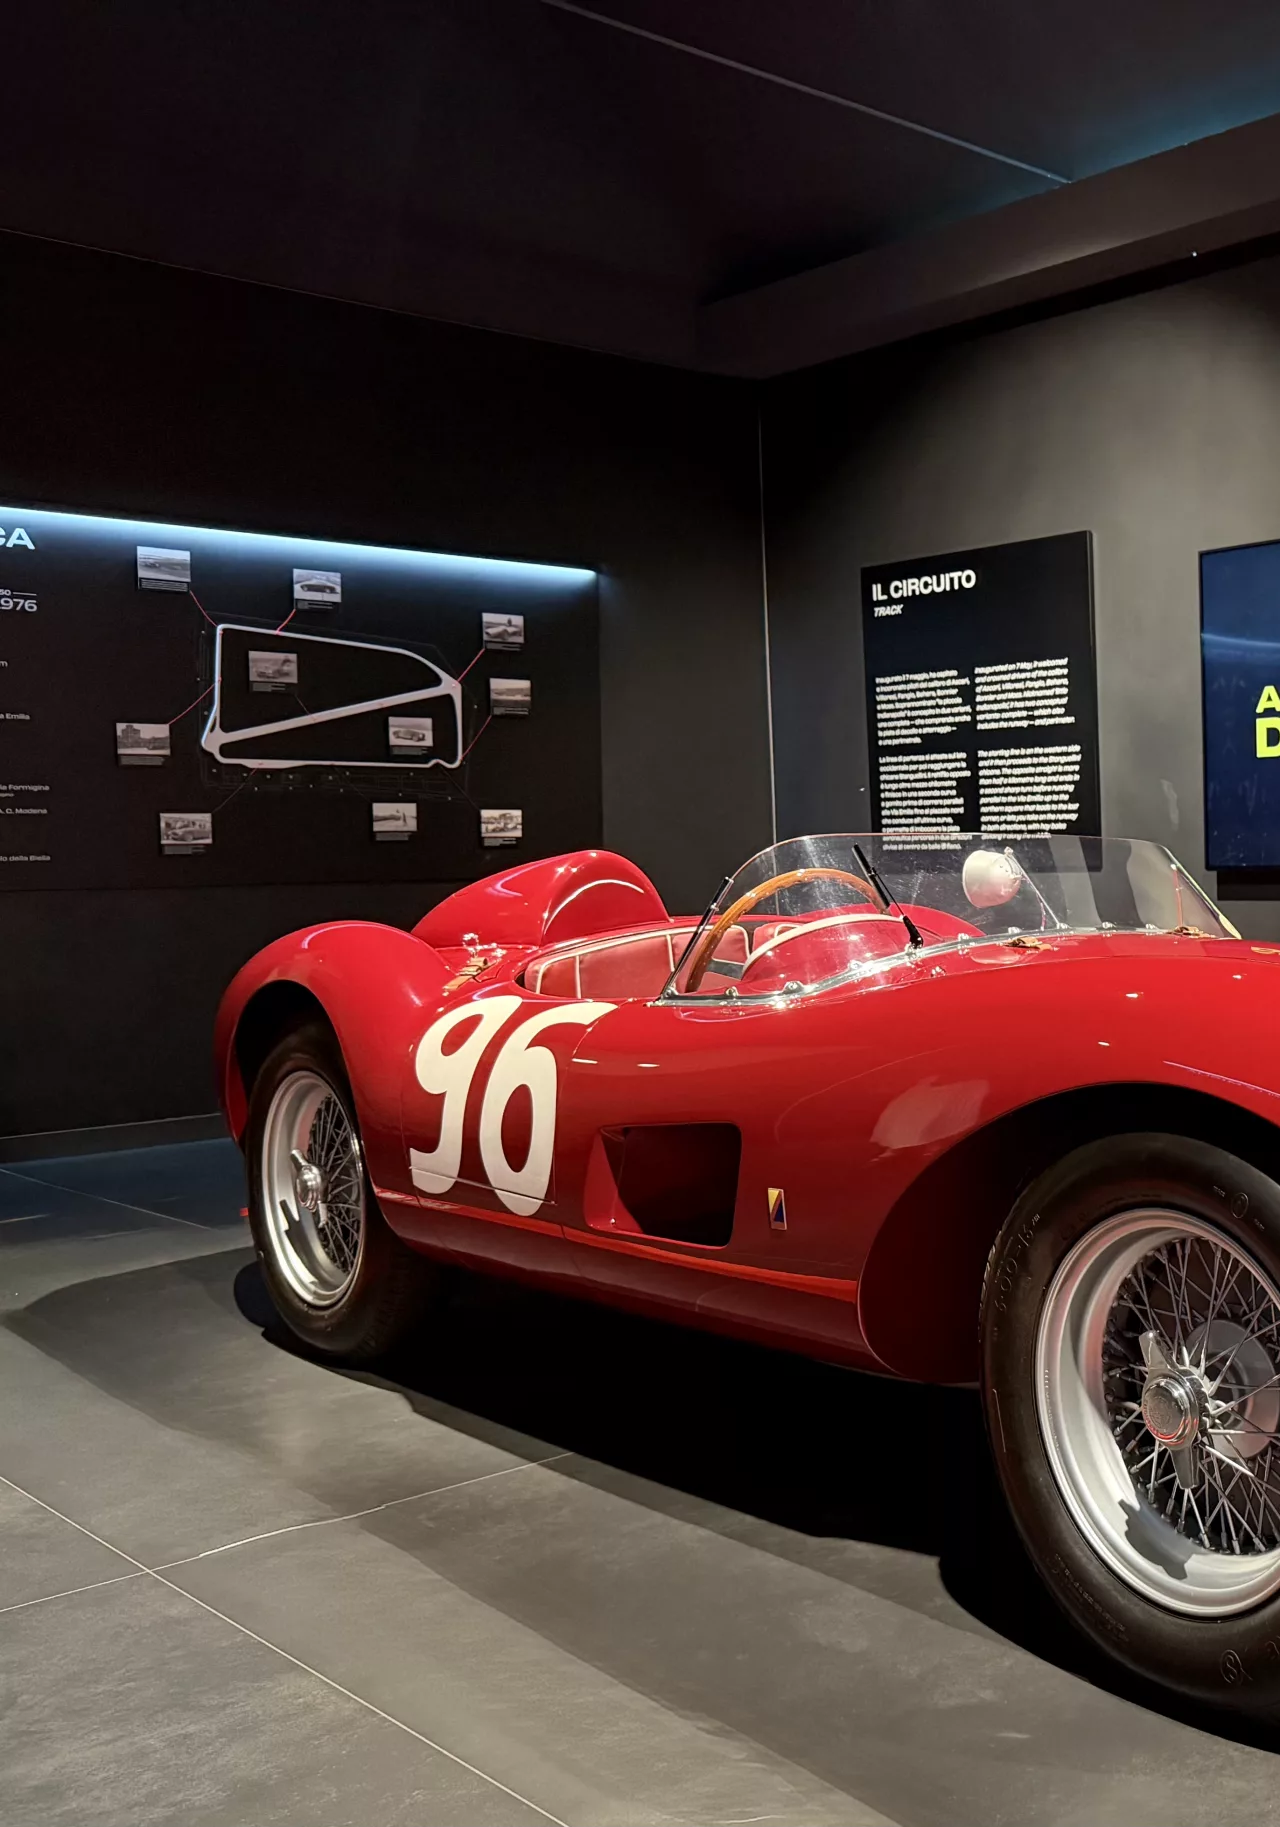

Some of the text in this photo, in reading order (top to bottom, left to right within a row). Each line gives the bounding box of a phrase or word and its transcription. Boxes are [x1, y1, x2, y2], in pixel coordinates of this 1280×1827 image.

[0, 527, 36, 551] A
[872, 569, 977, 602] IL CIRCUITO
[873, 604, 904, 617] TRACK
[409, 996, 619, 1216] 96
